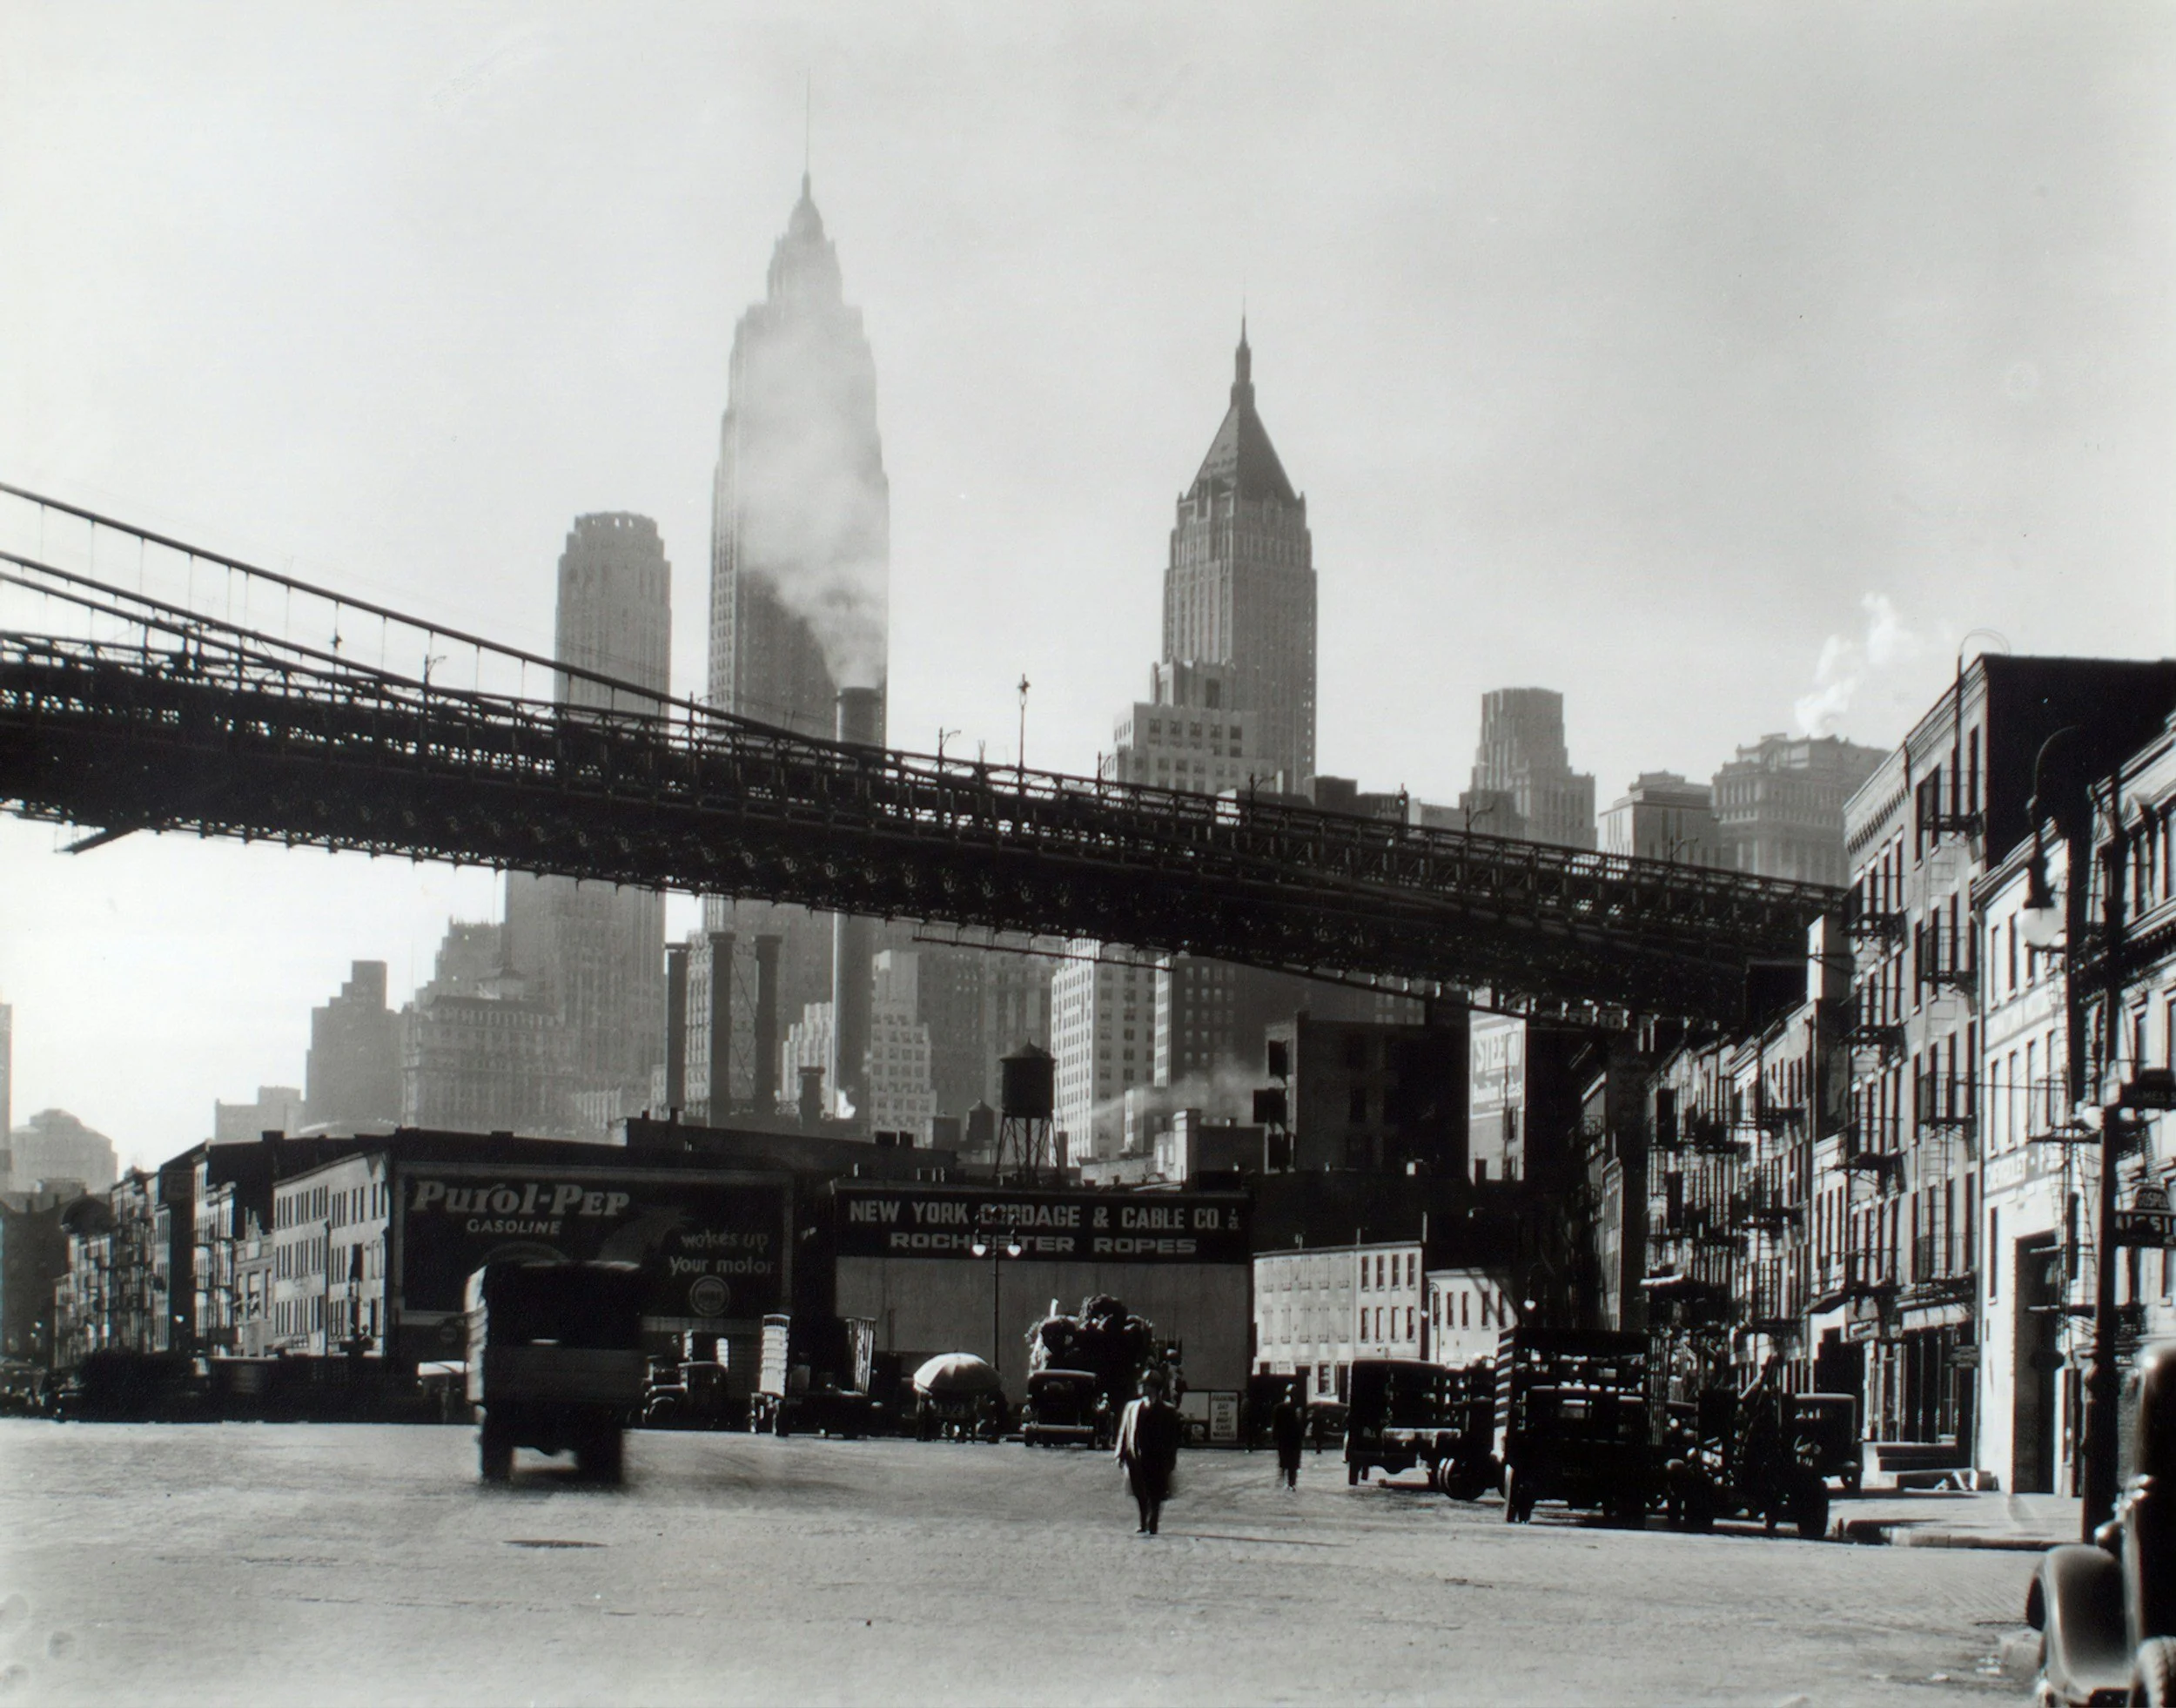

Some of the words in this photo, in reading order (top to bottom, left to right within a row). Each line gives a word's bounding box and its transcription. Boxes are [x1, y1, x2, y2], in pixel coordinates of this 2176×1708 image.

[850, 1200, 901, 1223] NEW
[912, 1202, 969, 1224] YORK
[1092, 1206, 1110, 1228] &
[1121, 1207, 1185, 1229] CABLE
[467, 1219, 562, 1234] GASOLINE
[681, 1228, 738, 1248] wakes
[743, 1234, 769, 1254] up
[1094, 1237, 1198, 1254] ROPES
[716, 1255, 774, 1274] motor
